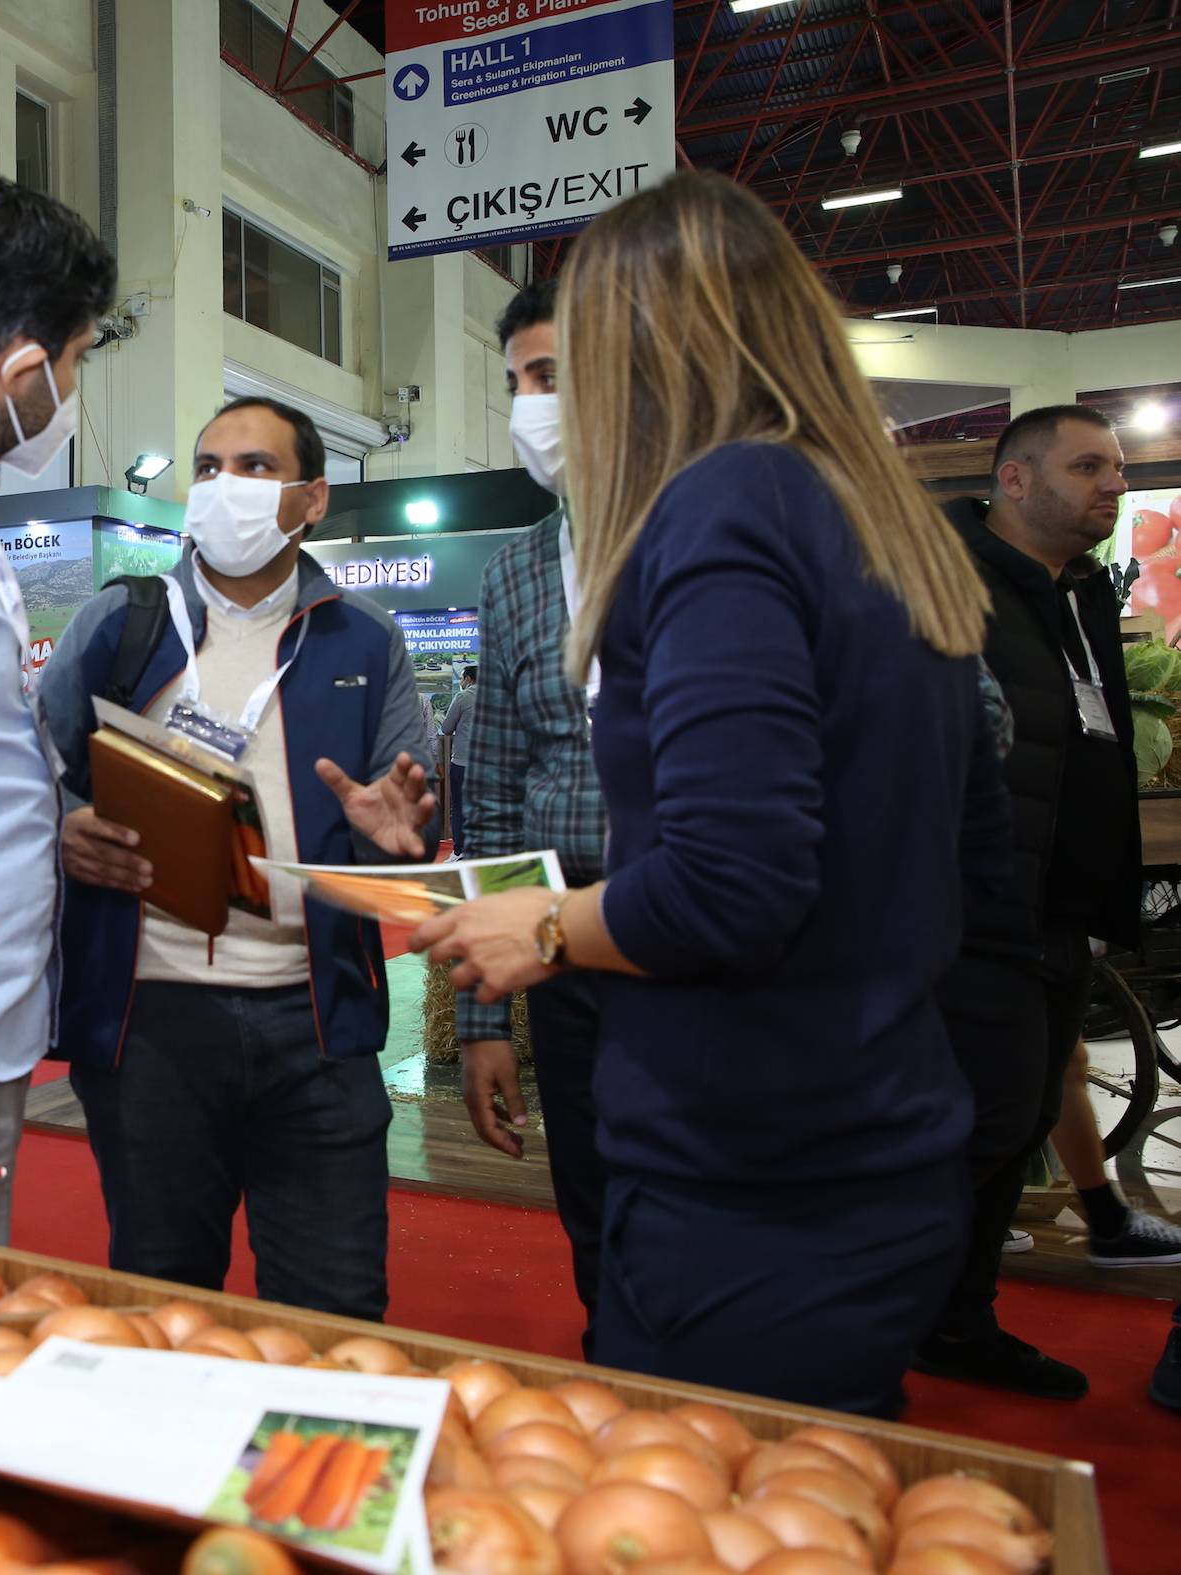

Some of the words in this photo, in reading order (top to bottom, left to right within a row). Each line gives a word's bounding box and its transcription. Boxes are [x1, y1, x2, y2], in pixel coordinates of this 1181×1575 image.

[415, 0, 480, 24] Tohum
[462, 8, 510, 33] Seed
[515, 2, 530, 19] &
[450, 46, 515, 73] HALL
[521, 37, 532, 56] 1
[451, 76, 474, 89] Sera
[475, 74, 483, 84] &
[485, 66, 521, 83] Sulama
[522, 52, 582, 74] Ekipmanları
[451, 83, 510, 102] Greenhouse
[512, 79, 520, 89] &
[521, 69, 567, 88] Irrigation
[569, 55, 626, 77] Equipment
[545, 106, 608, 143] WC
[447, 163, 649, 231] ÇIKIŞ/EXIT
[0, 539, 12, 551] in
[14, 534, 61, 550] BÖCEK
[12, 553, 38, 562] Belediye
[38, 551, 62, 560] Başkanı
[323, 555, 429, 585] LEDİYESİ
[405, 640, 417, 651] İP
[418, 640, 471, 651] ÇIKIYORUZ
